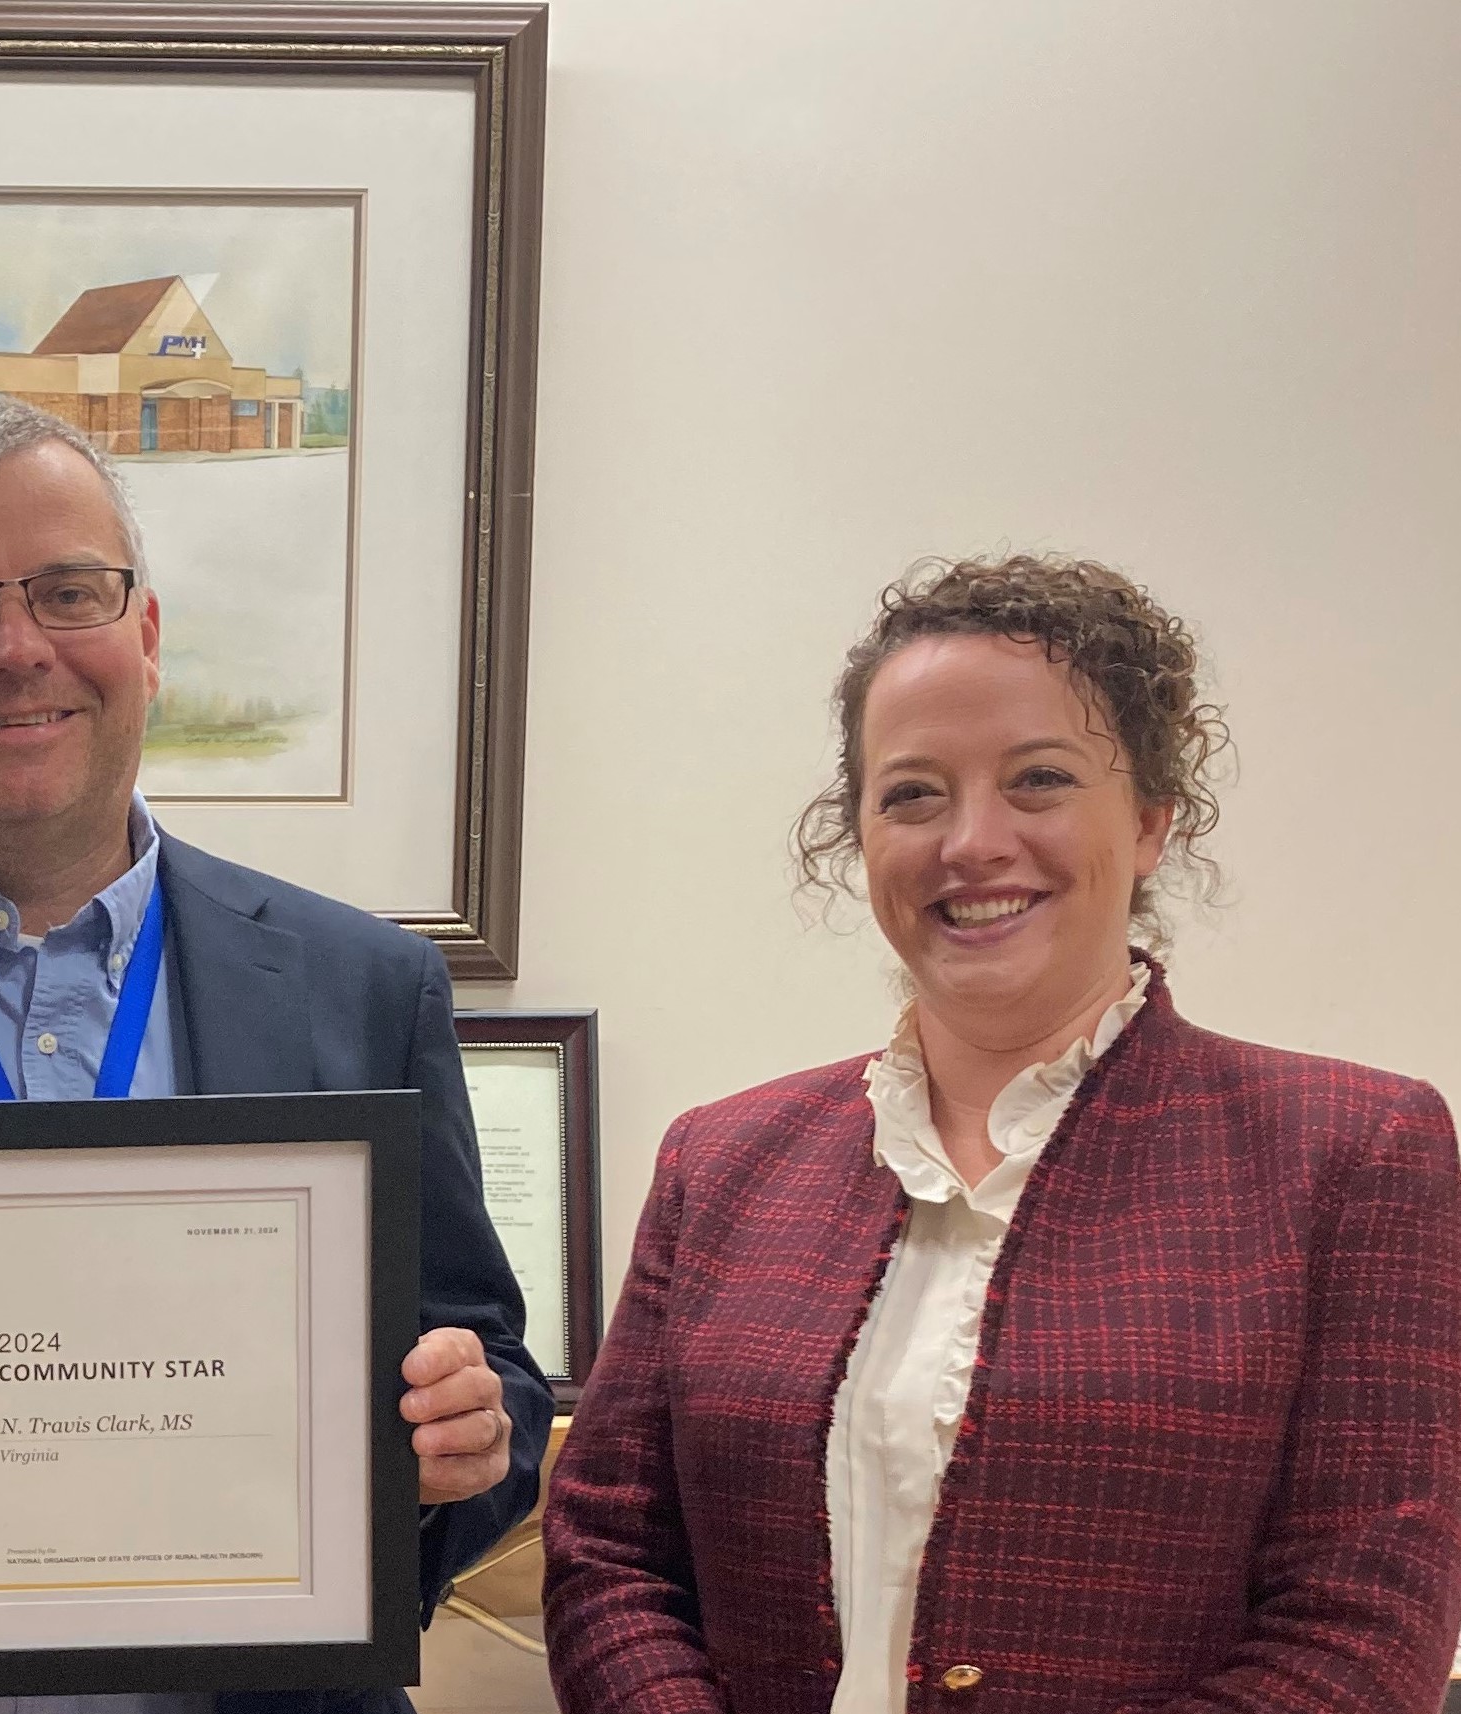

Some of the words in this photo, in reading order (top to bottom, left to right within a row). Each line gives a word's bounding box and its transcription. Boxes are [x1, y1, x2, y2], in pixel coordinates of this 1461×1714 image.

[165, 1359, 226, 1378] STAR
[0, 1418, 22, 1435] N.
[29, 1415, 91, 1434] Travis
[96, 1414, 155, 1433] Clark,
[160, 1413, 193, 1431] MS
[0, 1448, 59, 1465] Virginia
